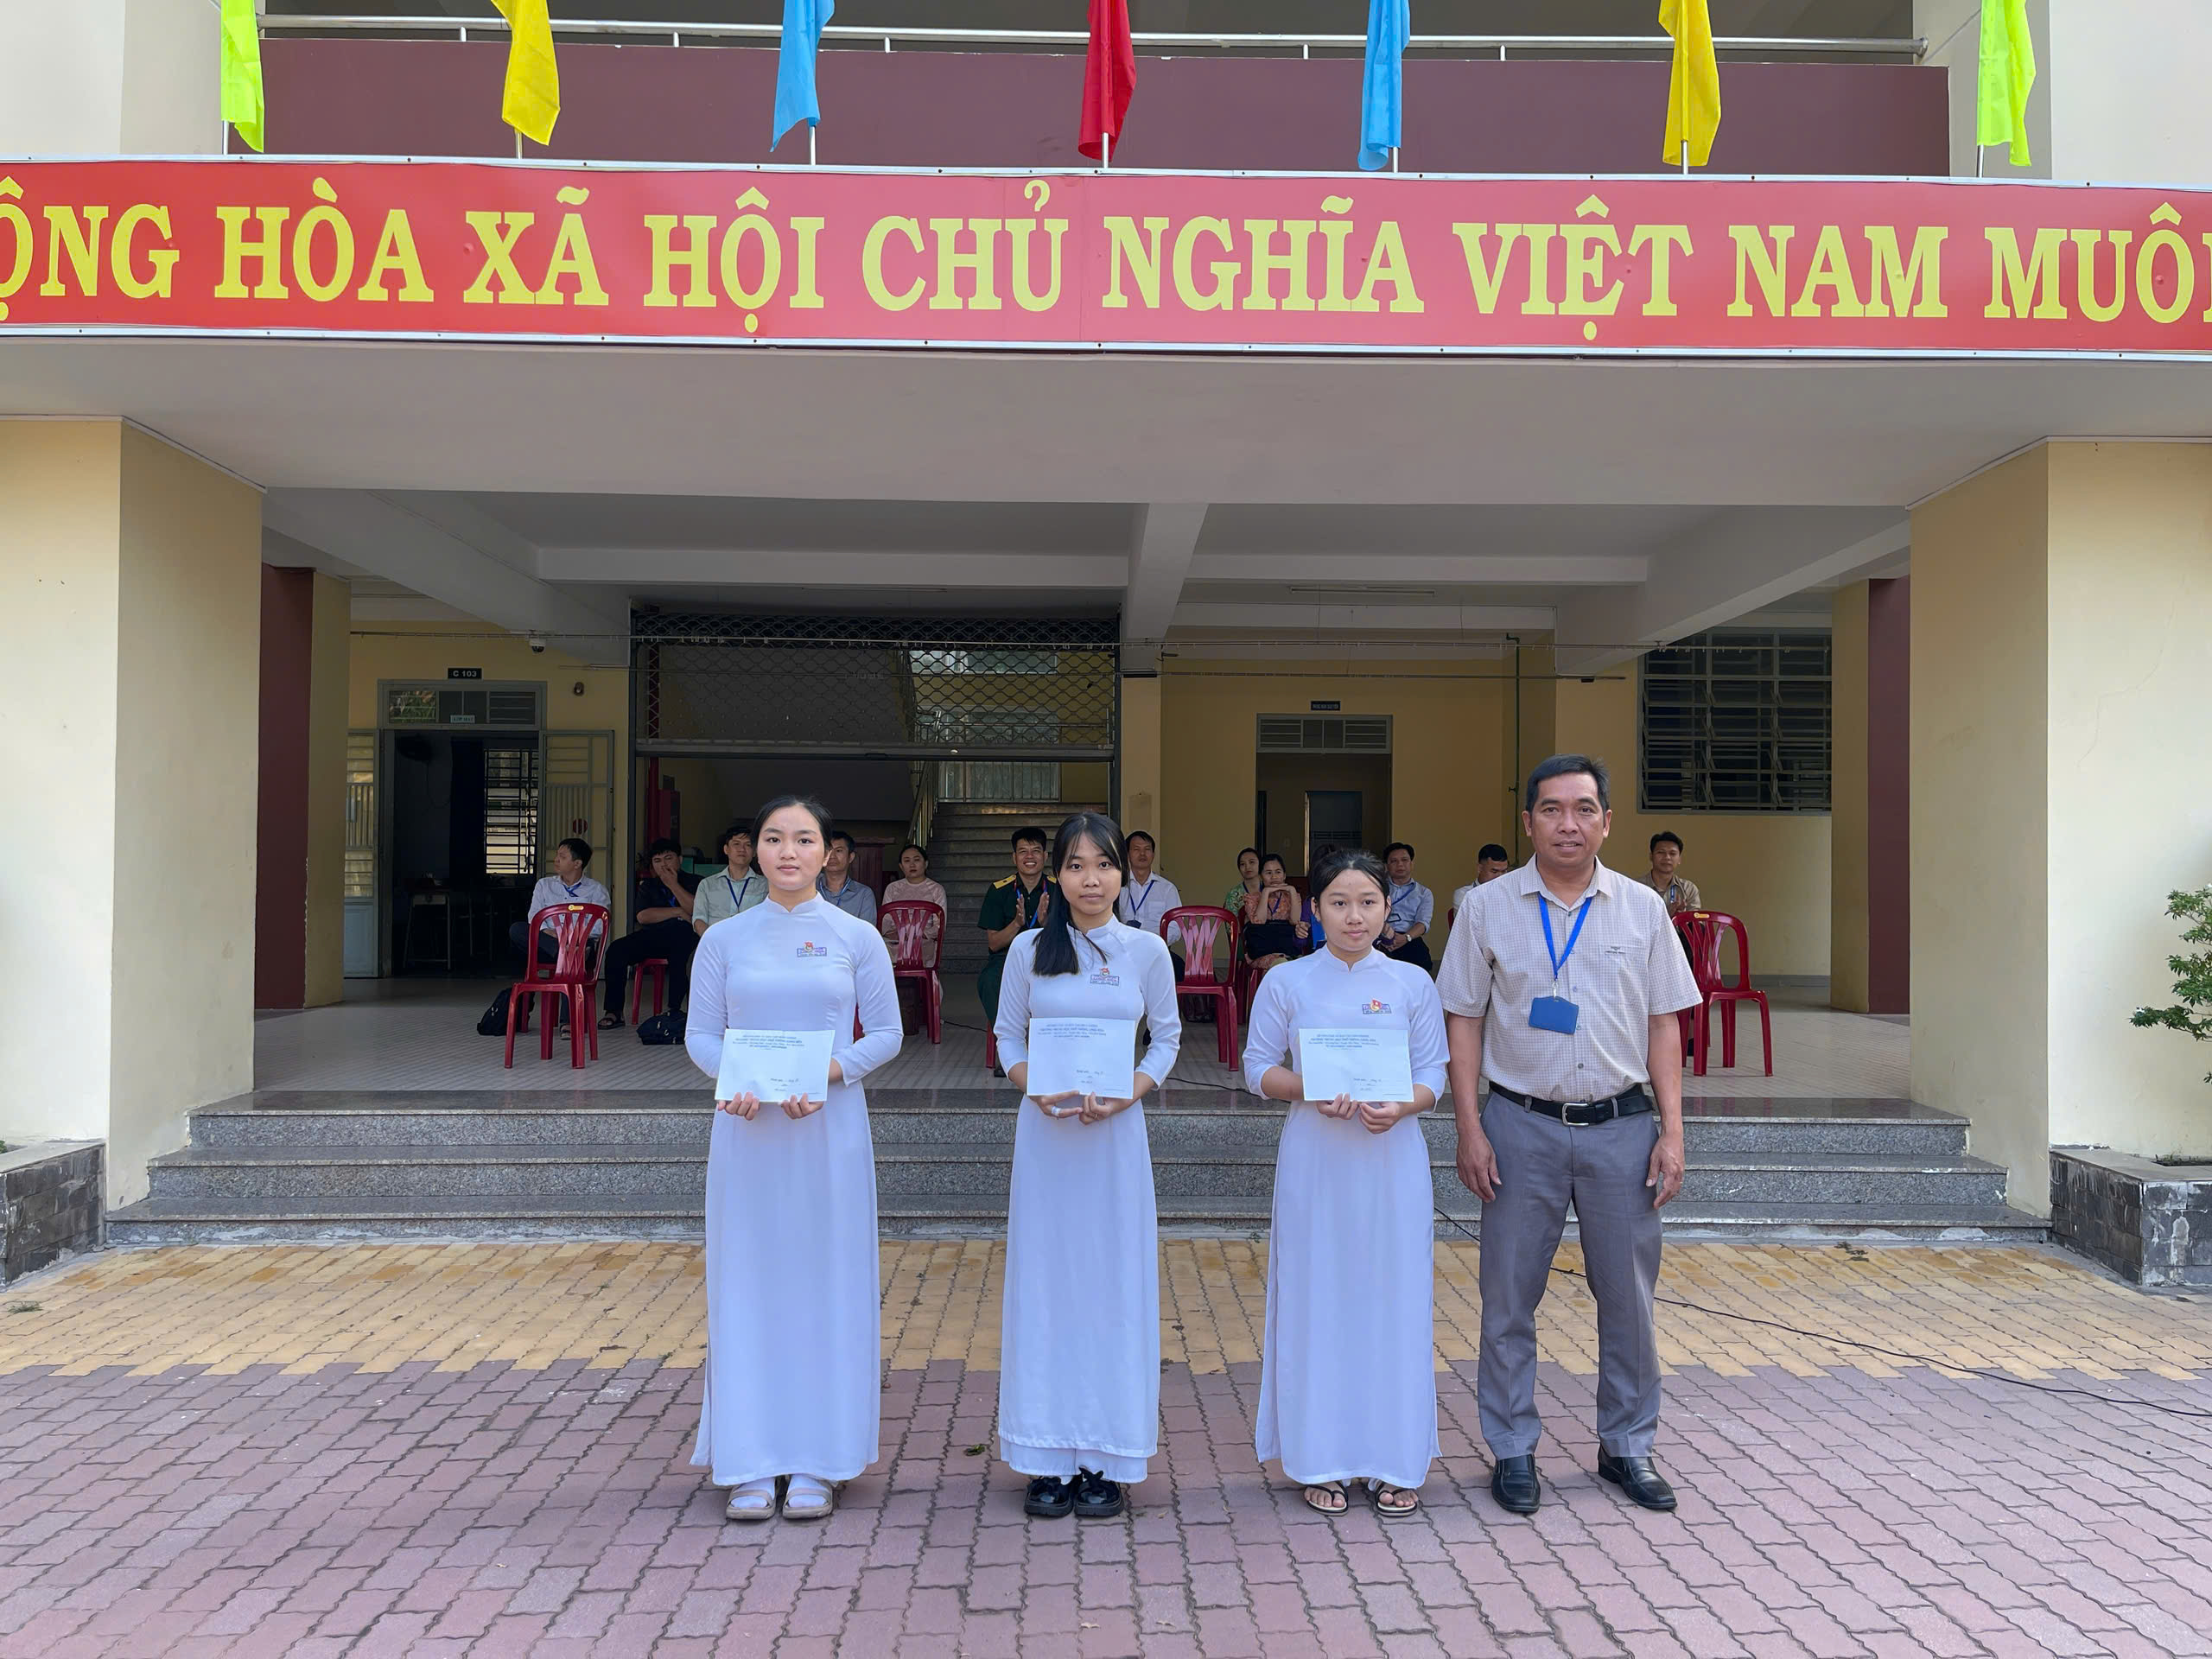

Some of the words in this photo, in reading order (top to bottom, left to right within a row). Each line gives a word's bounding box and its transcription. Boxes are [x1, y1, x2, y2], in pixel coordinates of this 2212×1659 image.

[214, 177, 434, 302] HÒA
[463, 186, 609, 306] XÃ
[644, 186, 824, 333] HỘI
[862, 180, 1068, 312] CHỦ
[1103, 195, 1424, 313] NGHĨA
[1452, 194, 1694, 340] VIỆT
[1727, 225, 1948, 318] NAM
[1984, 202, 2212, 324] MUÔ
